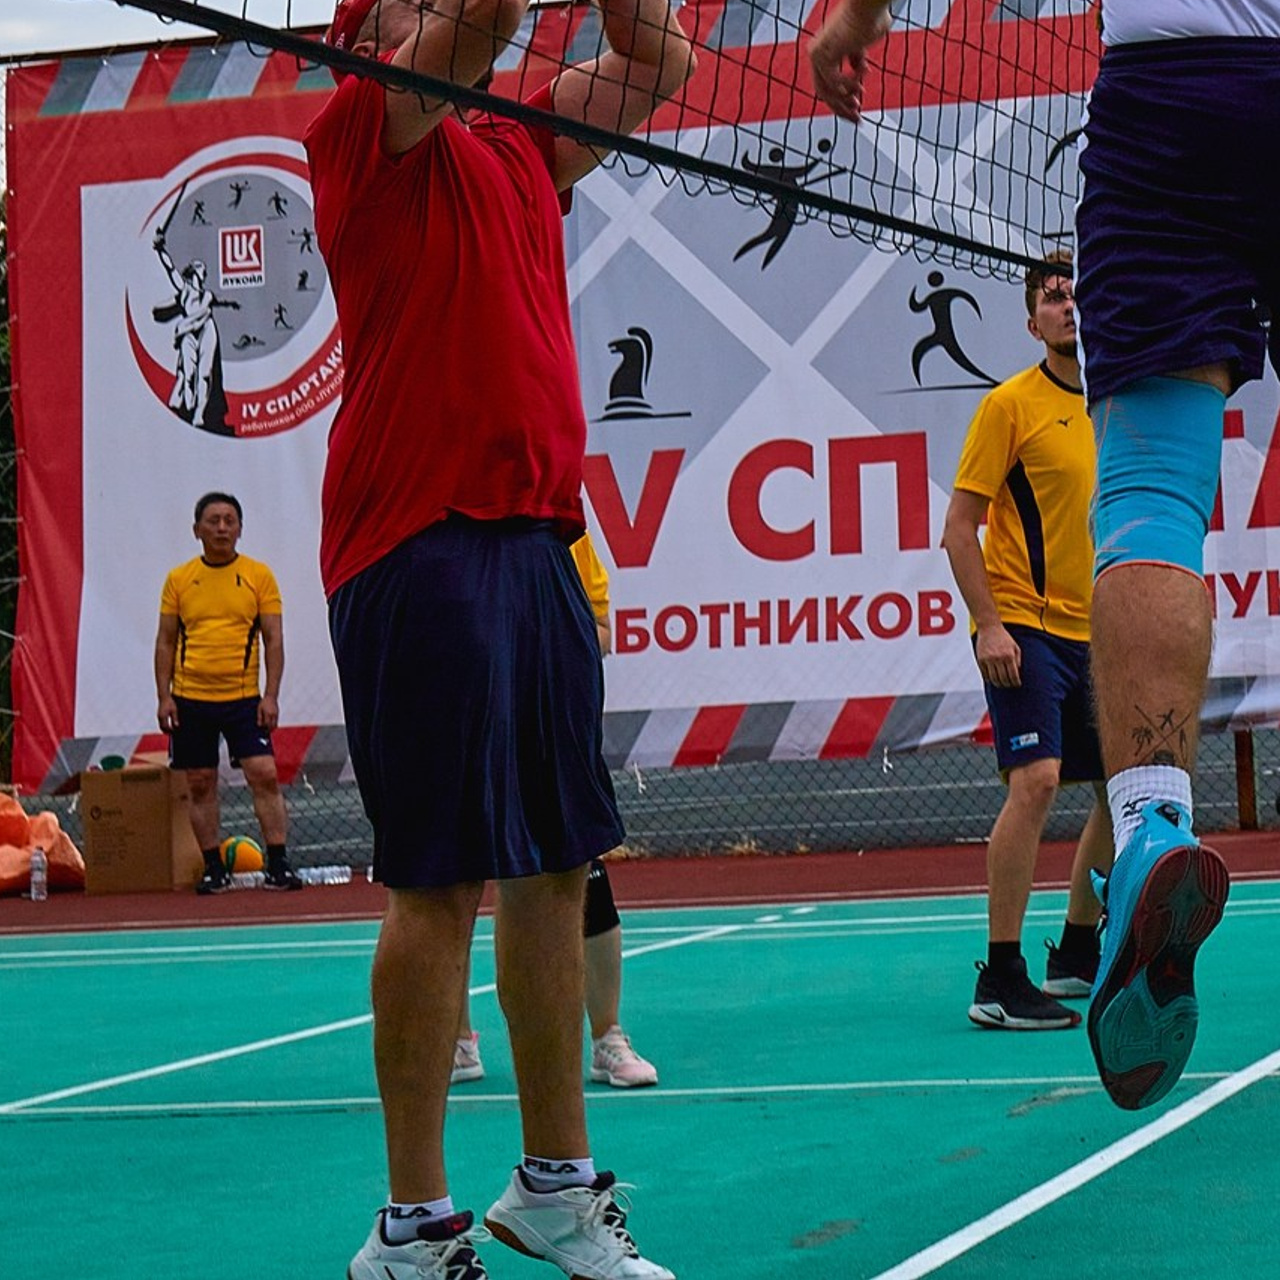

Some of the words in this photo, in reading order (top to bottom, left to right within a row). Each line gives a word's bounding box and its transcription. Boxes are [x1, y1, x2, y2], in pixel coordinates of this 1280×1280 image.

[241, 402, 261, 419] IV
[265, 338, 343, 415] СПАРТАКИ
[614, 590, 956, 656] БОТНИКОВ
[524, 1157, 580, 1174] FILA
